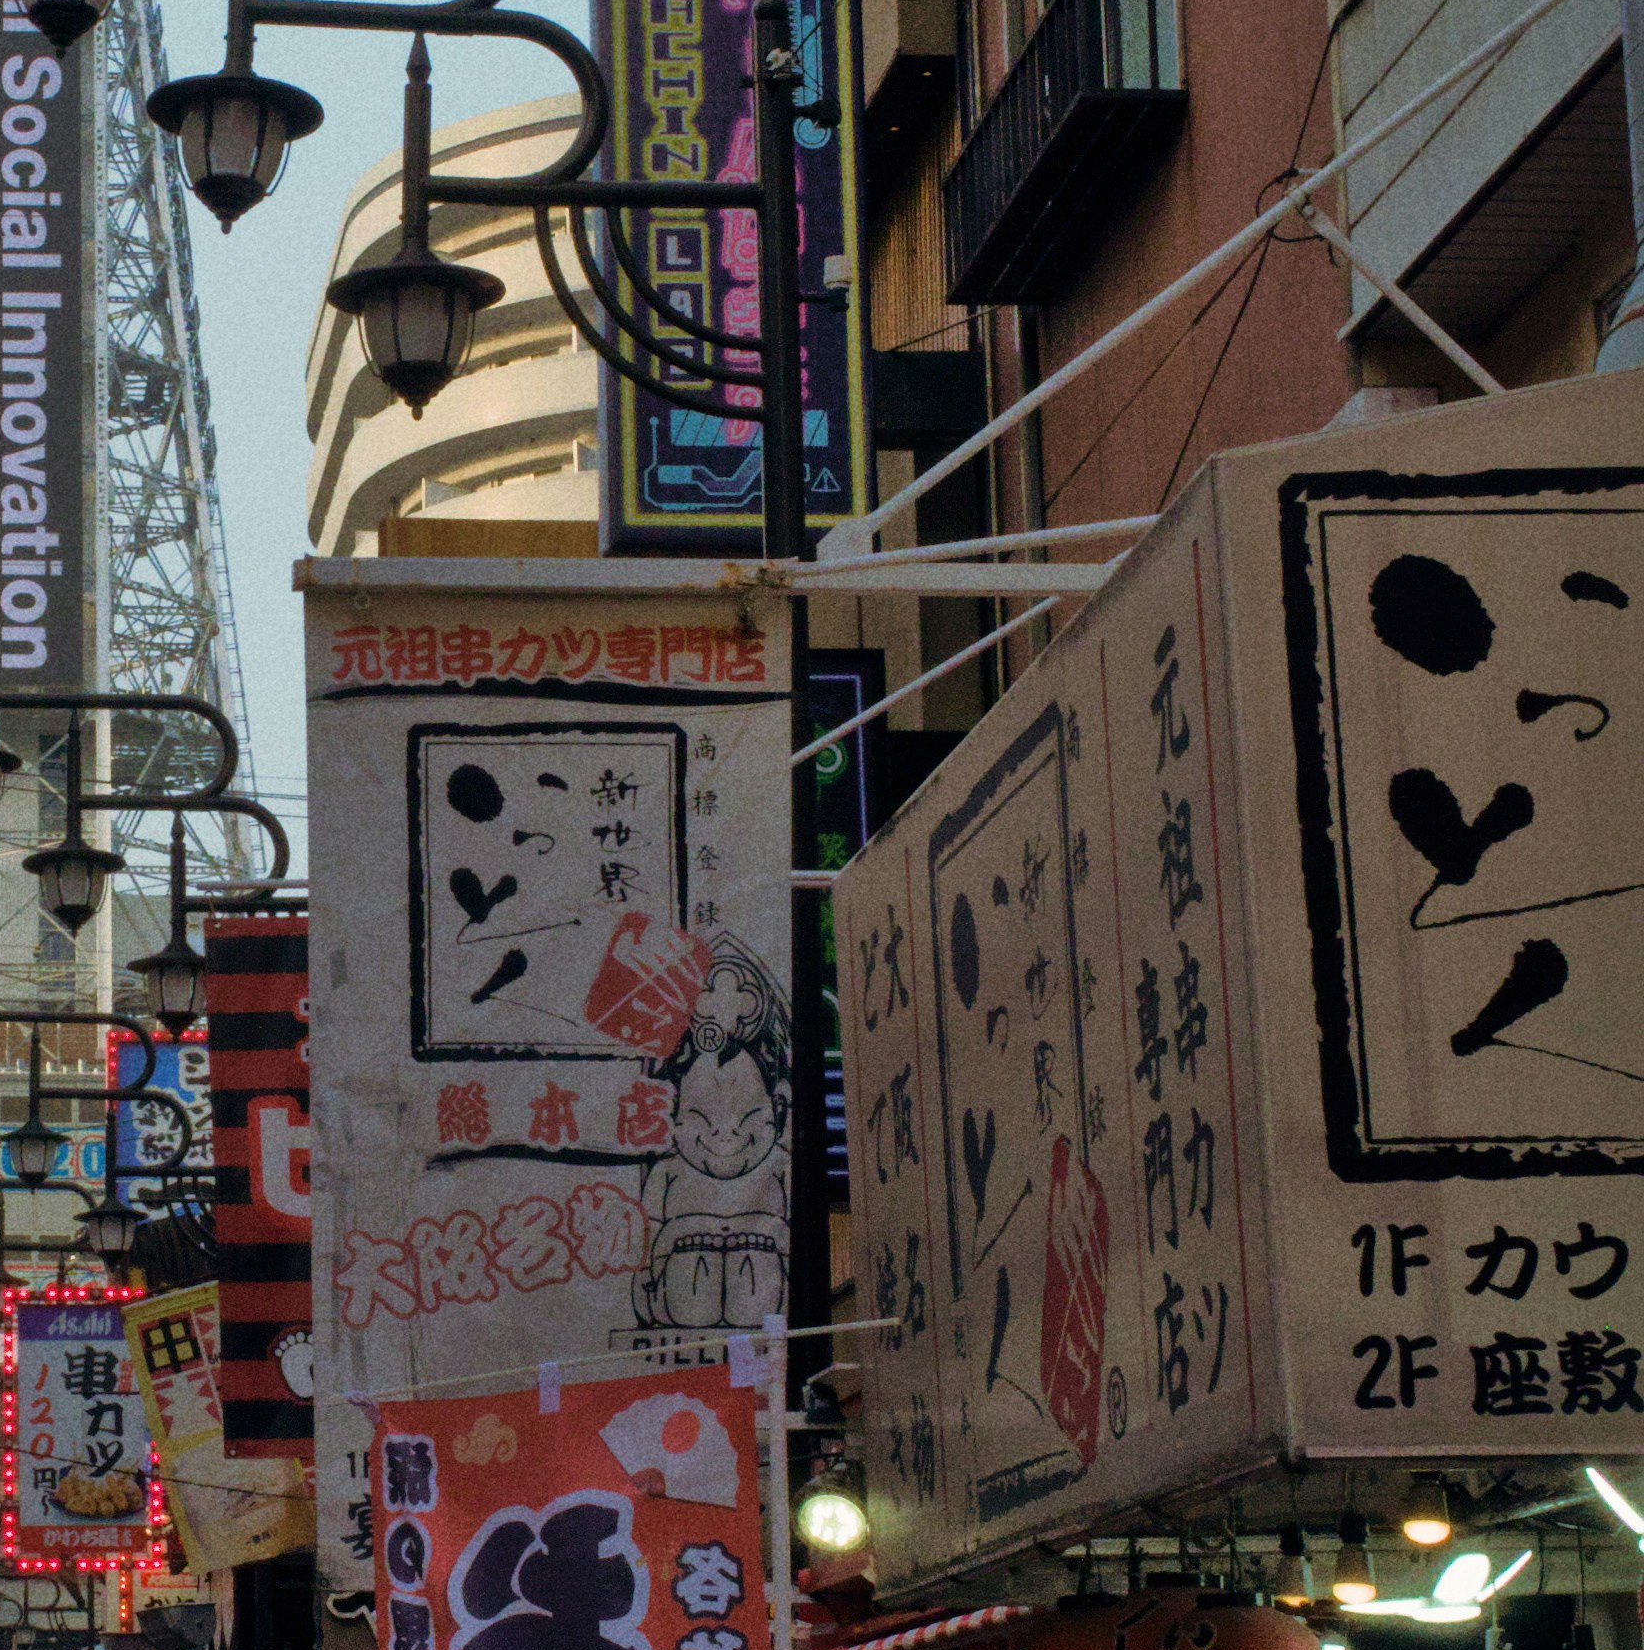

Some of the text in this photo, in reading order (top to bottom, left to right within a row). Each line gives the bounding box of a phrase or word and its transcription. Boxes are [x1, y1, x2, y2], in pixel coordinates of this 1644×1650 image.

[0, 54, 62, 268] Social
[0, 292, 63, 669] Innovation
[331, 624, 767, 685] 元祖串カツ専門店
[447, 764, 582, 1030] いっとく
[590, 768, 650, 902] 新世界
[692, 733, 722, 931] 商標登録
[1148, 627, 1227, 1395] 元祖串カツ
[437, 1081, 674, 1147] 総本店
[337, 1182, 649, 1328] 大阪名物
[1136, 959, 1193, 1417] 専門店
[47, 1311, 112, 1337] Asahi
[1352, 1222, 1629, 1299] 1F カウ
[61, 1345, 124, 1478] 串カツ
[1353, 1330, 1644, 1416] 2F 座敷
